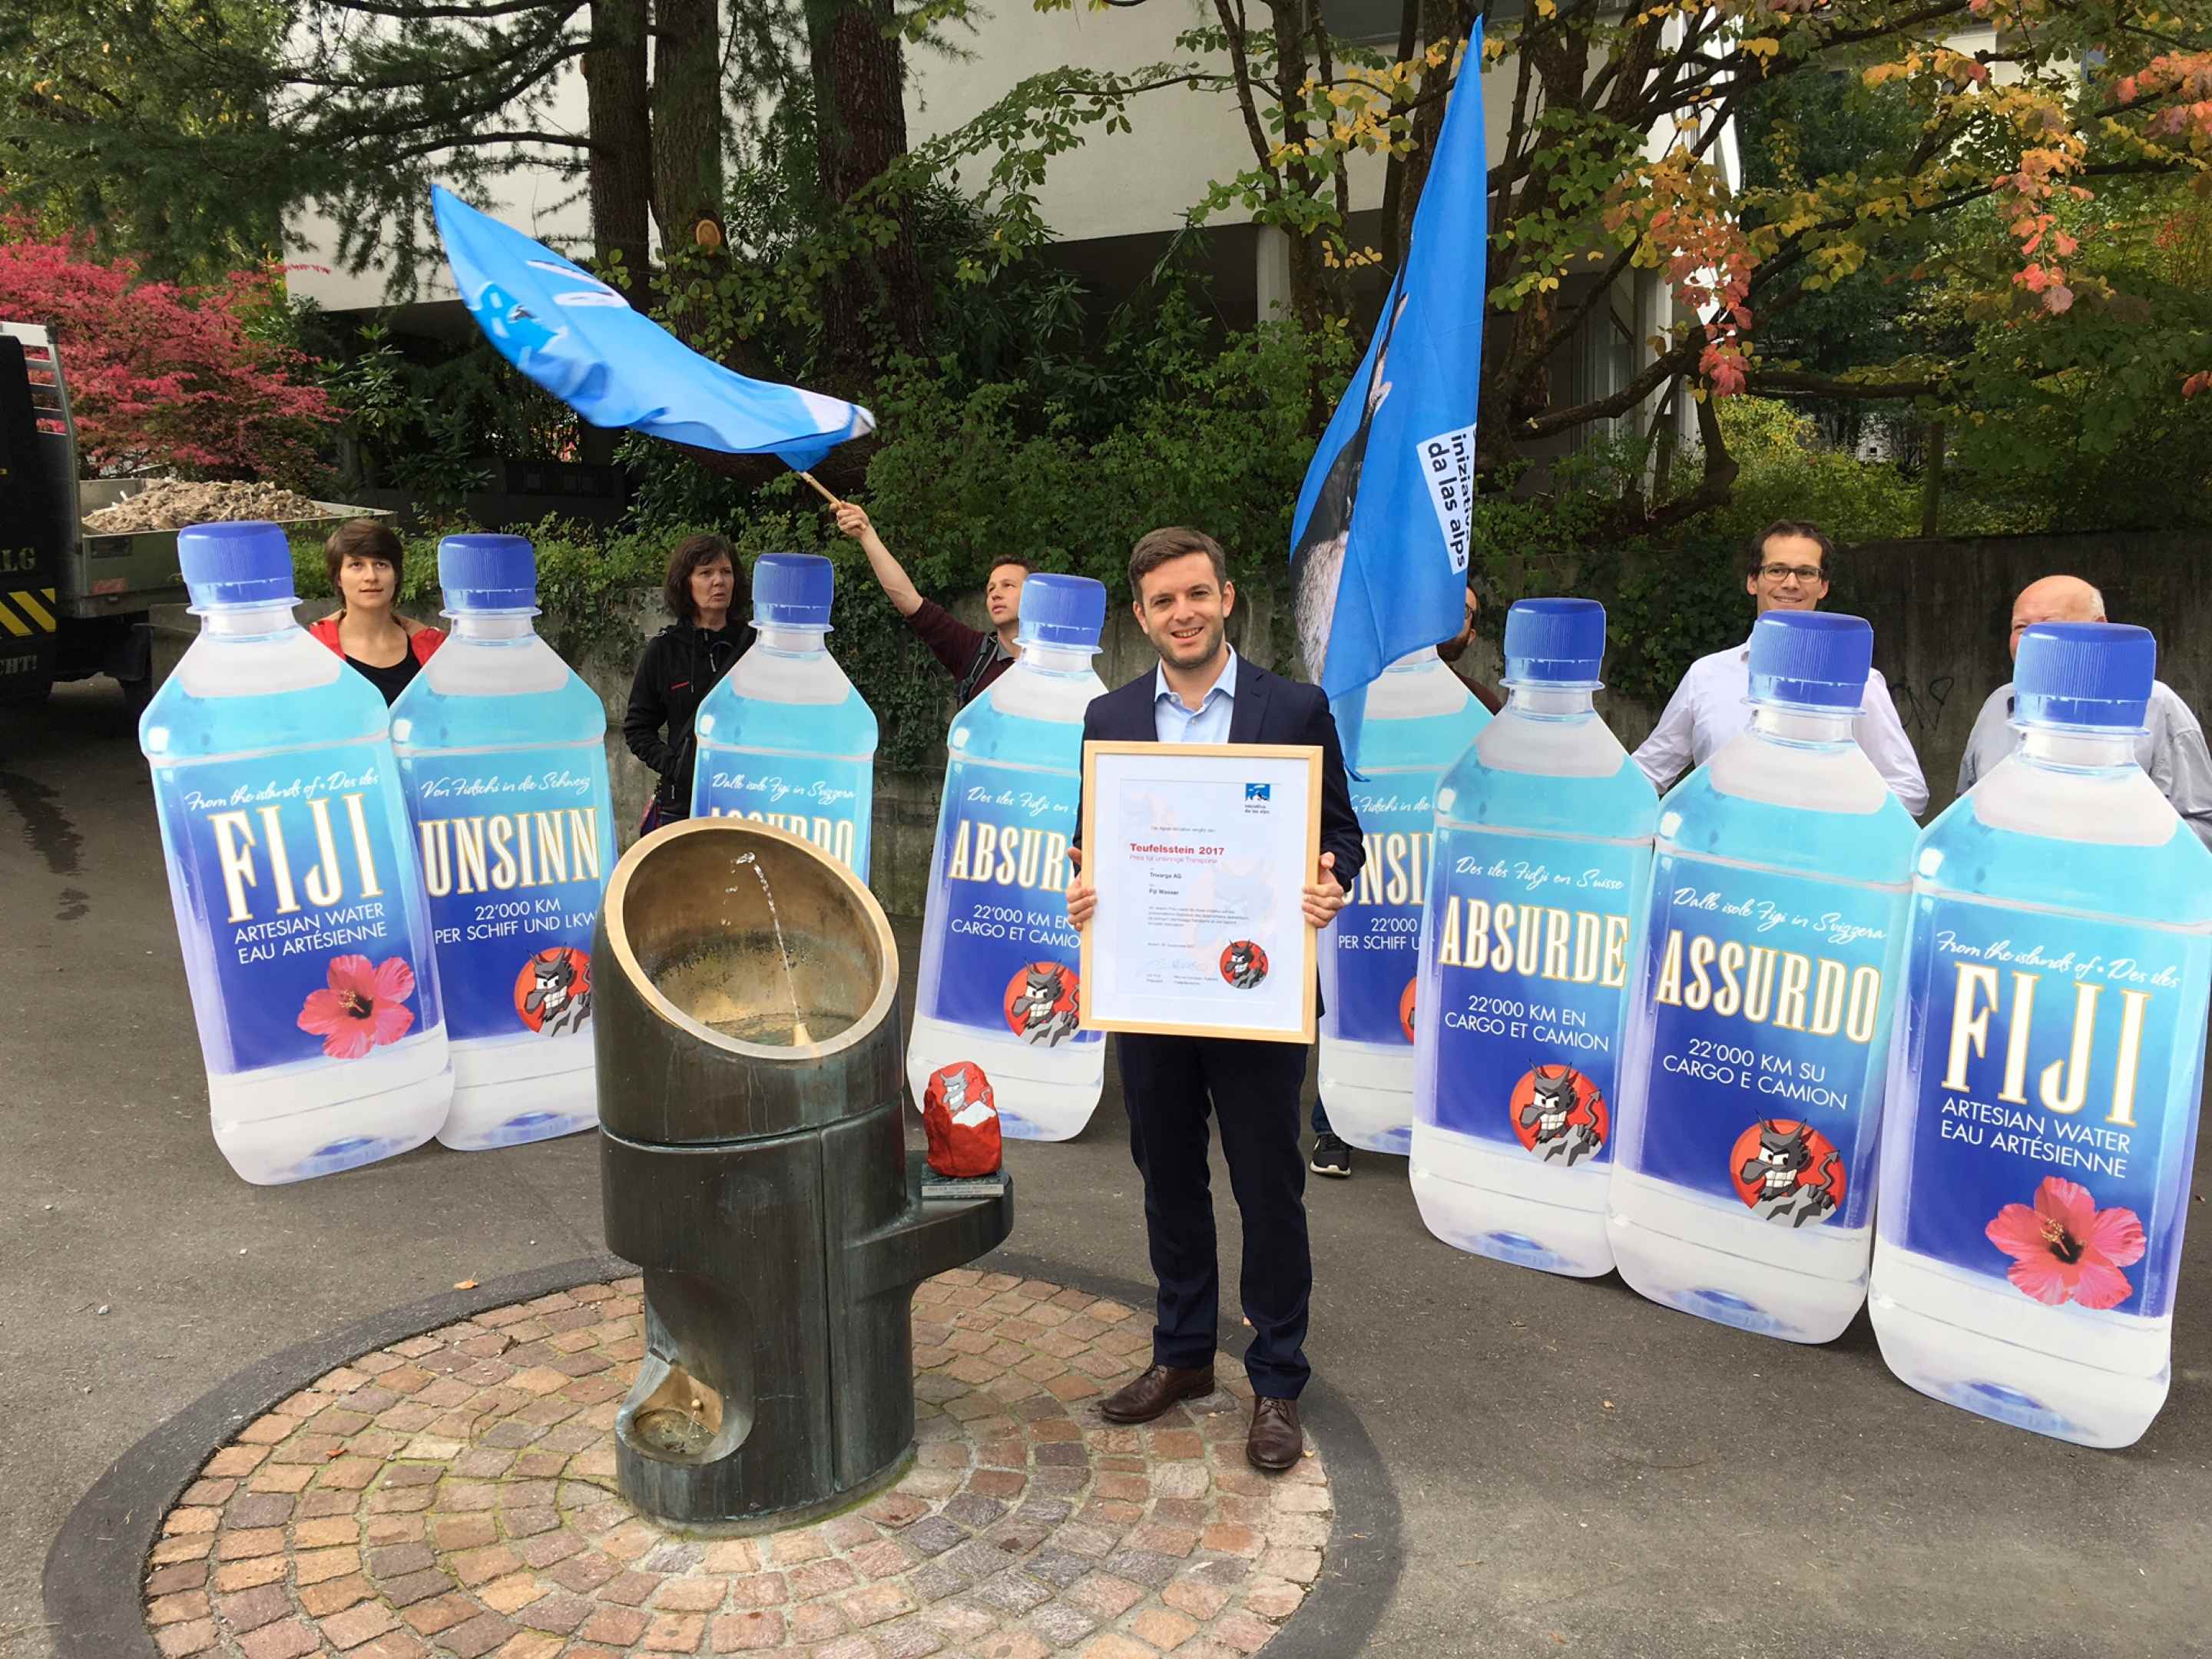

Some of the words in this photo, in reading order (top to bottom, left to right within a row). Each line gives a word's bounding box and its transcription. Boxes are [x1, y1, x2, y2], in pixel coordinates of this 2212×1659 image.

[1428, 442, 1450, 472] da
[1439, 477, 1457, 512] las
[1449, 518, 1465, 567] alps
[0, 547, 36, 572] LG
[184, 791, 227, 811] From
[231, 784, 253, 804] the
[257, 779, 301, 801] islands
[303, 777, 320, 799] of
[328, 771, 356, 790] Des
[421, 777, 449, 798] Von
[452, 776, 499, 796] Fidschi
[502, 781, 515, 793] in
[518, 774, 538, 790] die
[538, 770, 591, 796] Schweiz
[713, 773, 745, 790] Dalle
[793, 785, 804, 796] in
[968, 786, 992, 803] Des
[1020, 792, 1050, 817] Fidji
[1053, 804, 1068, 813] en
[1400, 803, 1412, 812] in
[207, 793, 383, 923] FIJI
[417, 806, 601, 897] UNSINN
[948, 819, 1075, 892] ABSUR
[1131, 843, 1194, 854] Teufelsstein
[1199, 846, 1224, 856] 2017
[1343, 833, 1434, 906] NSI
[1455, 856, 1483, 876] Des
[1514, 861, 1550, 892] Fidji
[1553, 873, 1571, 885] en
[1577, 869, 1624, 889] Suisse
[234, 914, 320, 945] ARTESIAN
[326, 903, 384, 927] WATER
[435, 927, 462, 945] PER
[466, 920, 519, 941] SCHIFF
[524, 916, 560, 933] UND
[565, 909, 598, 929] LKW
[475, 901, 531, 921] 22'000
[535, 898, 561, 914] KM
[973, 904, 1023, 923] 22'000
[1027, 912, 1050, 927] KM
[1371, 918, 1418, 933] 22'000
[1674, 887, 1721, 910] Dalle
[1722, 899, 1755, 917] isole
[1757, 901, 1786, 932] Figi
[1791, 915, 1808, 928] in
[1813, 912, 1887, 945] Svizzera
[238, 943, 275, 964] EAU
[282, 922, 387, 956] ARTÉSIENNE
[952, 919, 1005, 939] CARGO
[1009, 926, 1025, 941] ET
[1029, 929, 1081, 949] CAMIO
[1339, 935, 1359, 950] PER
[1364, 935, 1406, 950] SCHIFF
[1438, 896, 1629, 988] ABSURDE
[1936, 931, 1980, 957] From
[1984, 939, 2013, 962] the
[2015, 945, 2076, 972] islands
[2075, 956, 2101, 979] of
[2107, 958, 2146, 983] Des
[1655, 929, 1882, 1044] ASSURDO
[1444, 1012, 1506, 1037] CARGO
[1511, 1022, 1528, 1039] ET
[1532, 1026, 1610, 1052] CAMION
[1469, 995, 1525, 1018] 22'000
[1529, 1005, 1557, 1024] KM
[1562, 1011, 1586, 1028] EN
[1689, 1038, 1755, 1068] 22'000
[1760, 1054, 1793, 1077] KM
[1799, 1062, 1826, 1083] SU
[1941, 961, 2152, 1128] FIJI
[1663, 1055, 1734, 1084] CARGO
[1740, 1071, 1751, 1089] E
[1757, 1077, 1848, 1111] CAMION
[1942, 1098, 2045, 1136] ARTESIAN
[2054, 1118, 2131, 1154] WATER
[1941, 1118, 1984, 1147] EAU
[1990, 1130, 2127, 1179] ARTÉSIENNE
